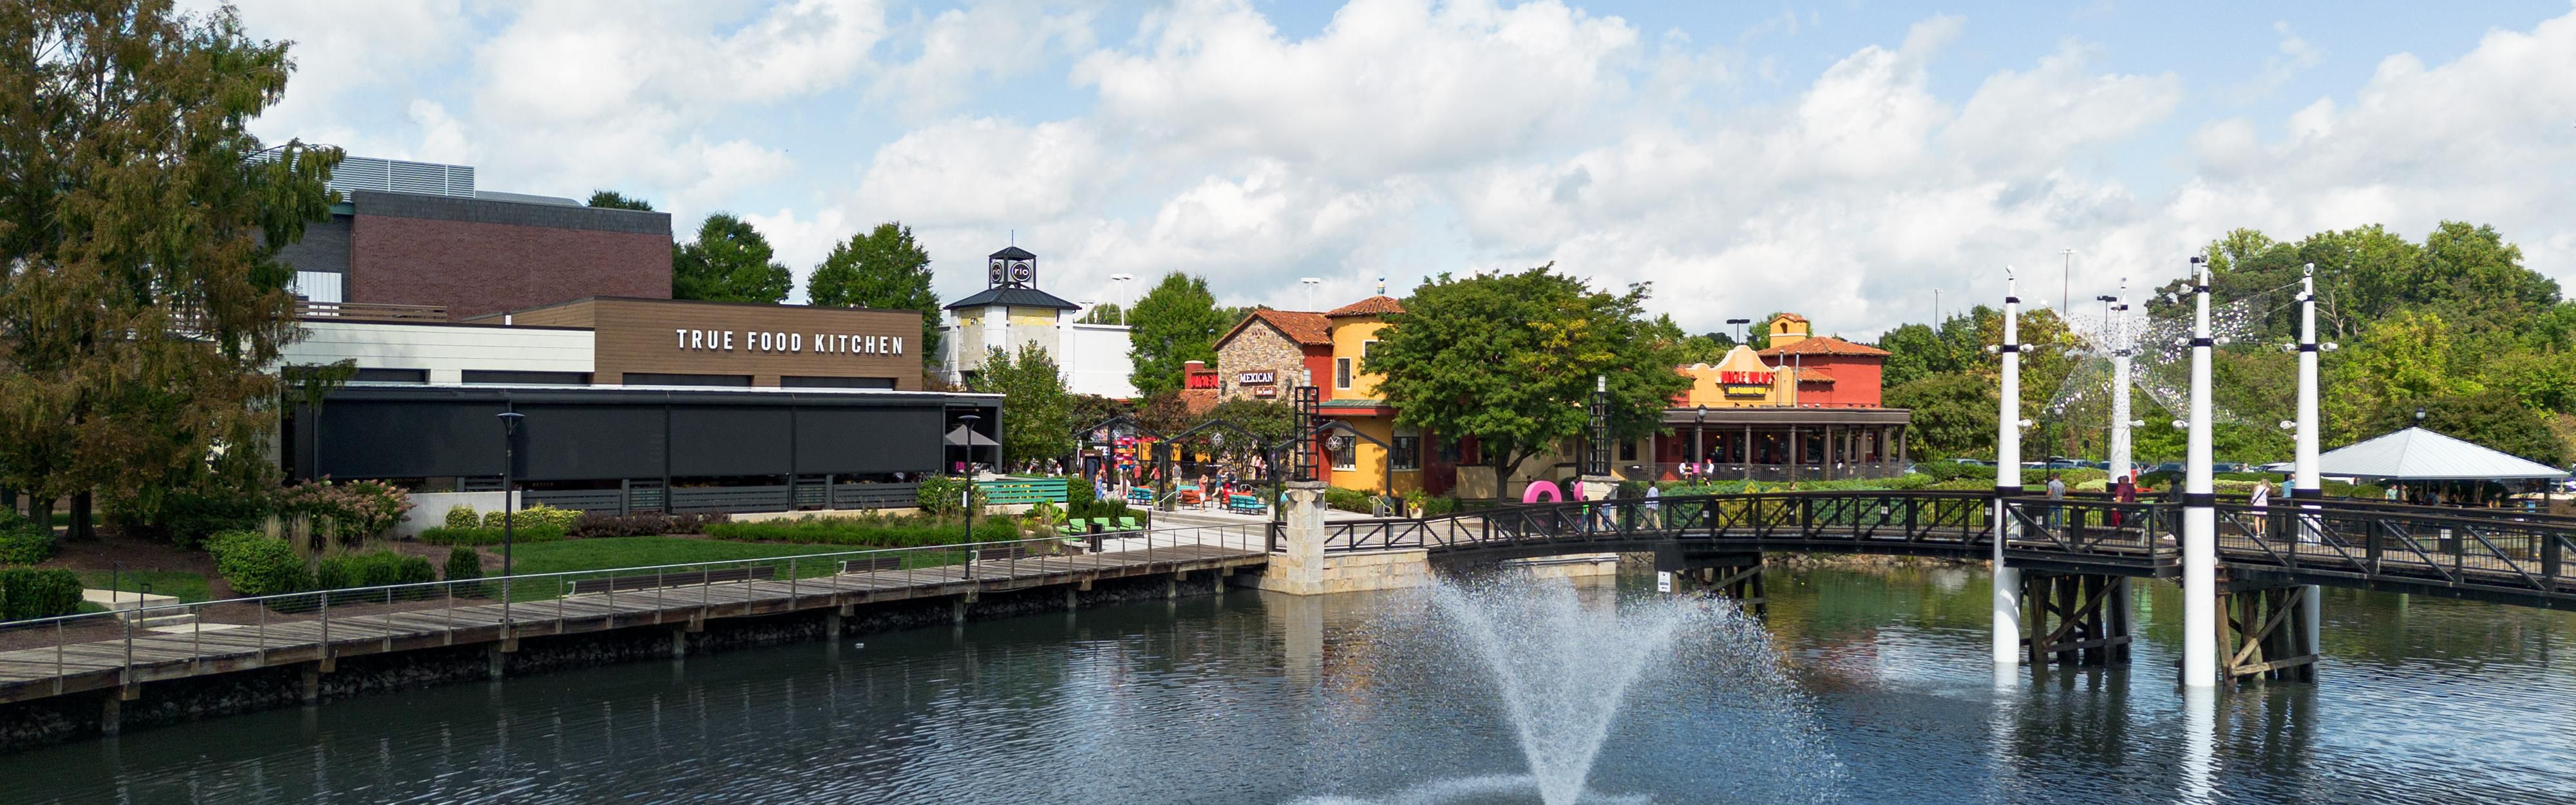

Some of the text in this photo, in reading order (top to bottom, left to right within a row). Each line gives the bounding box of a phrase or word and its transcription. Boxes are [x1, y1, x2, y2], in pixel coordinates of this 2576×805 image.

[1014, 267, 1028, 276] rio
[676, 329, 902, 354] TRUE FOOD KITCHEN
[1239, 372, 1274, 383] MEXICAN
